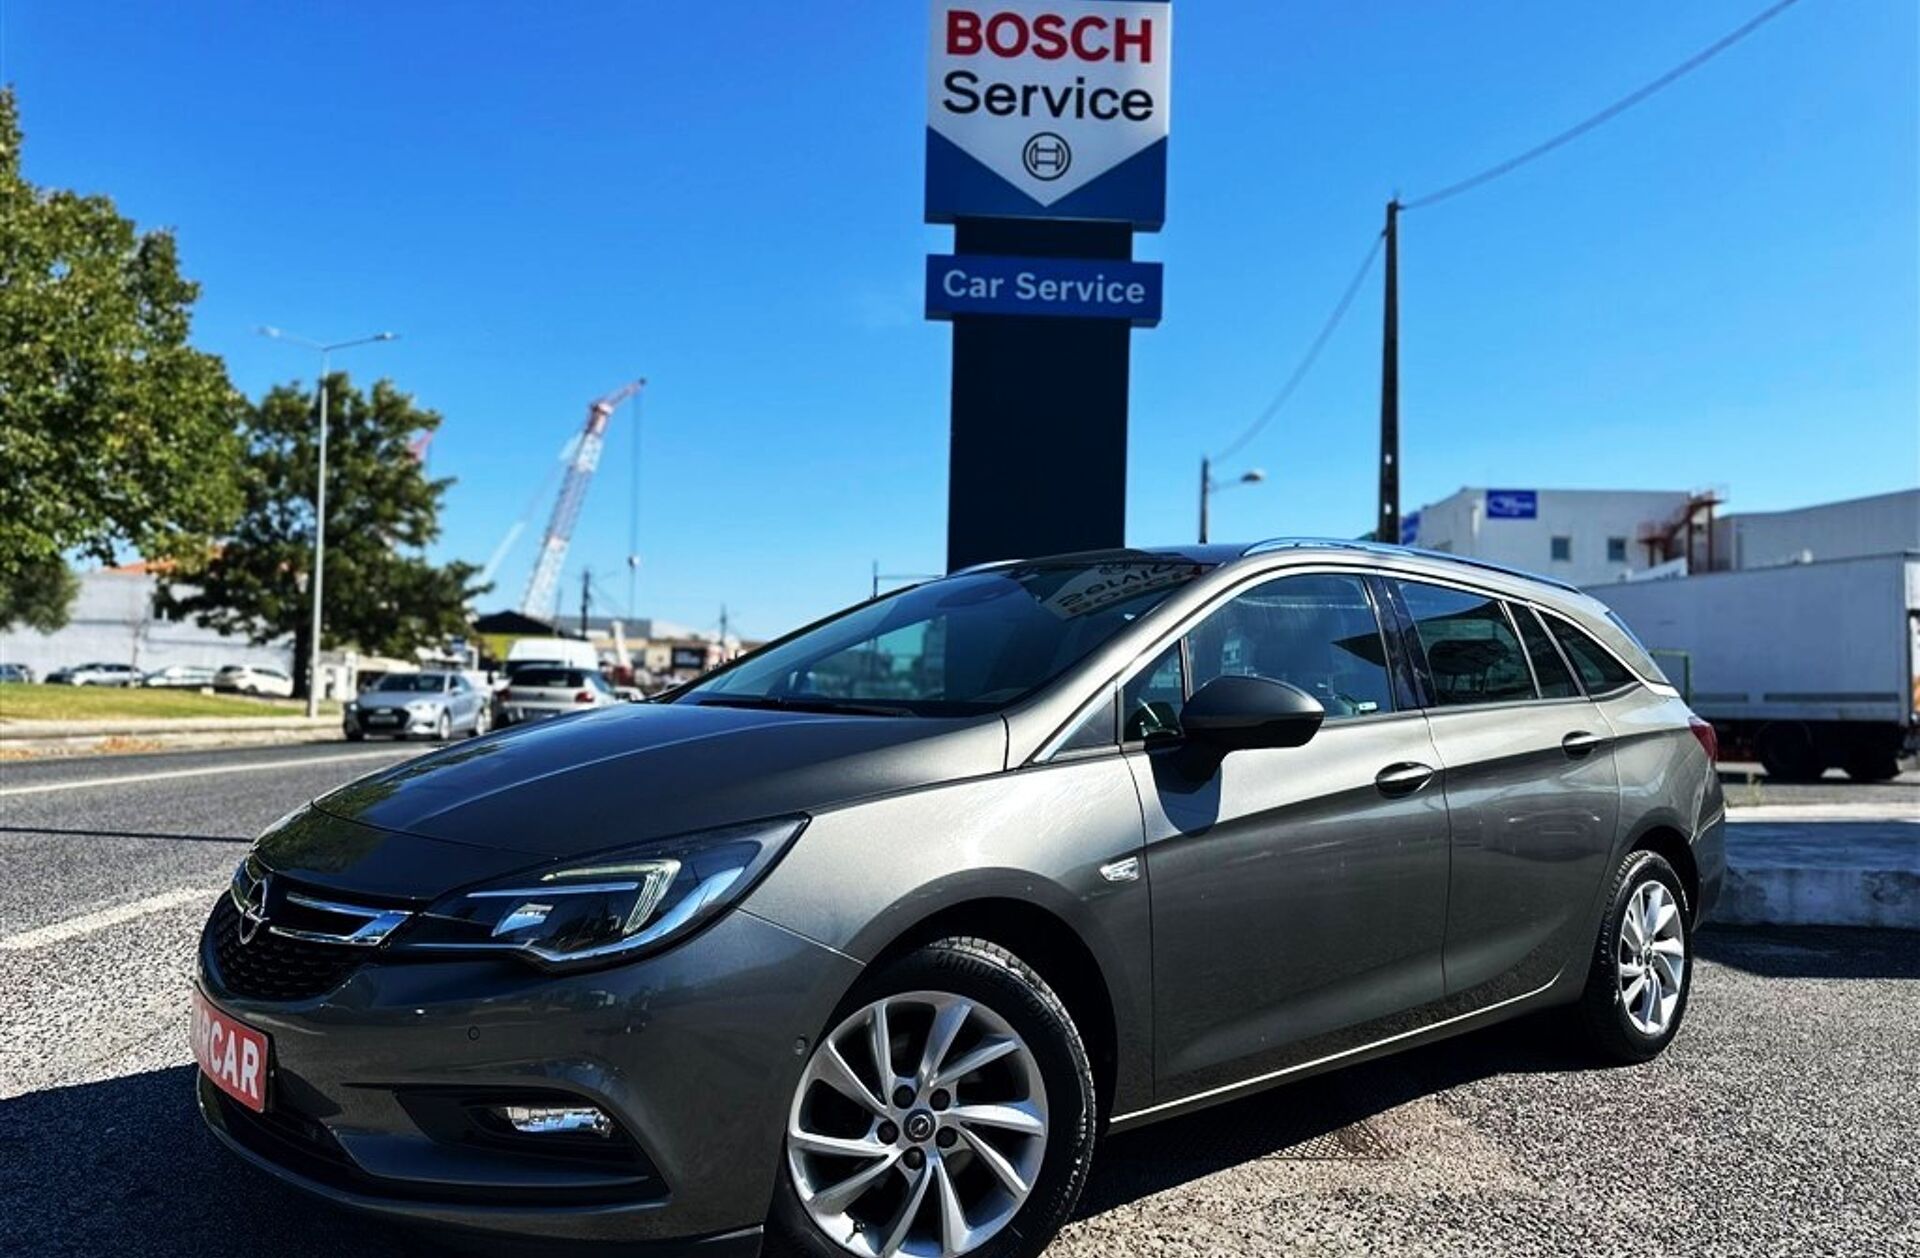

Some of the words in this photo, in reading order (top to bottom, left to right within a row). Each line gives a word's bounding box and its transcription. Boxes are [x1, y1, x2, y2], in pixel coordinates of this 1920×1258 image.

[946, 9, 1153, 63] BOSCH
[942, 70, 1154, 122] Service
[943, 269, 1004, 298] Car
[1015, 272, 1146, 304] Service
